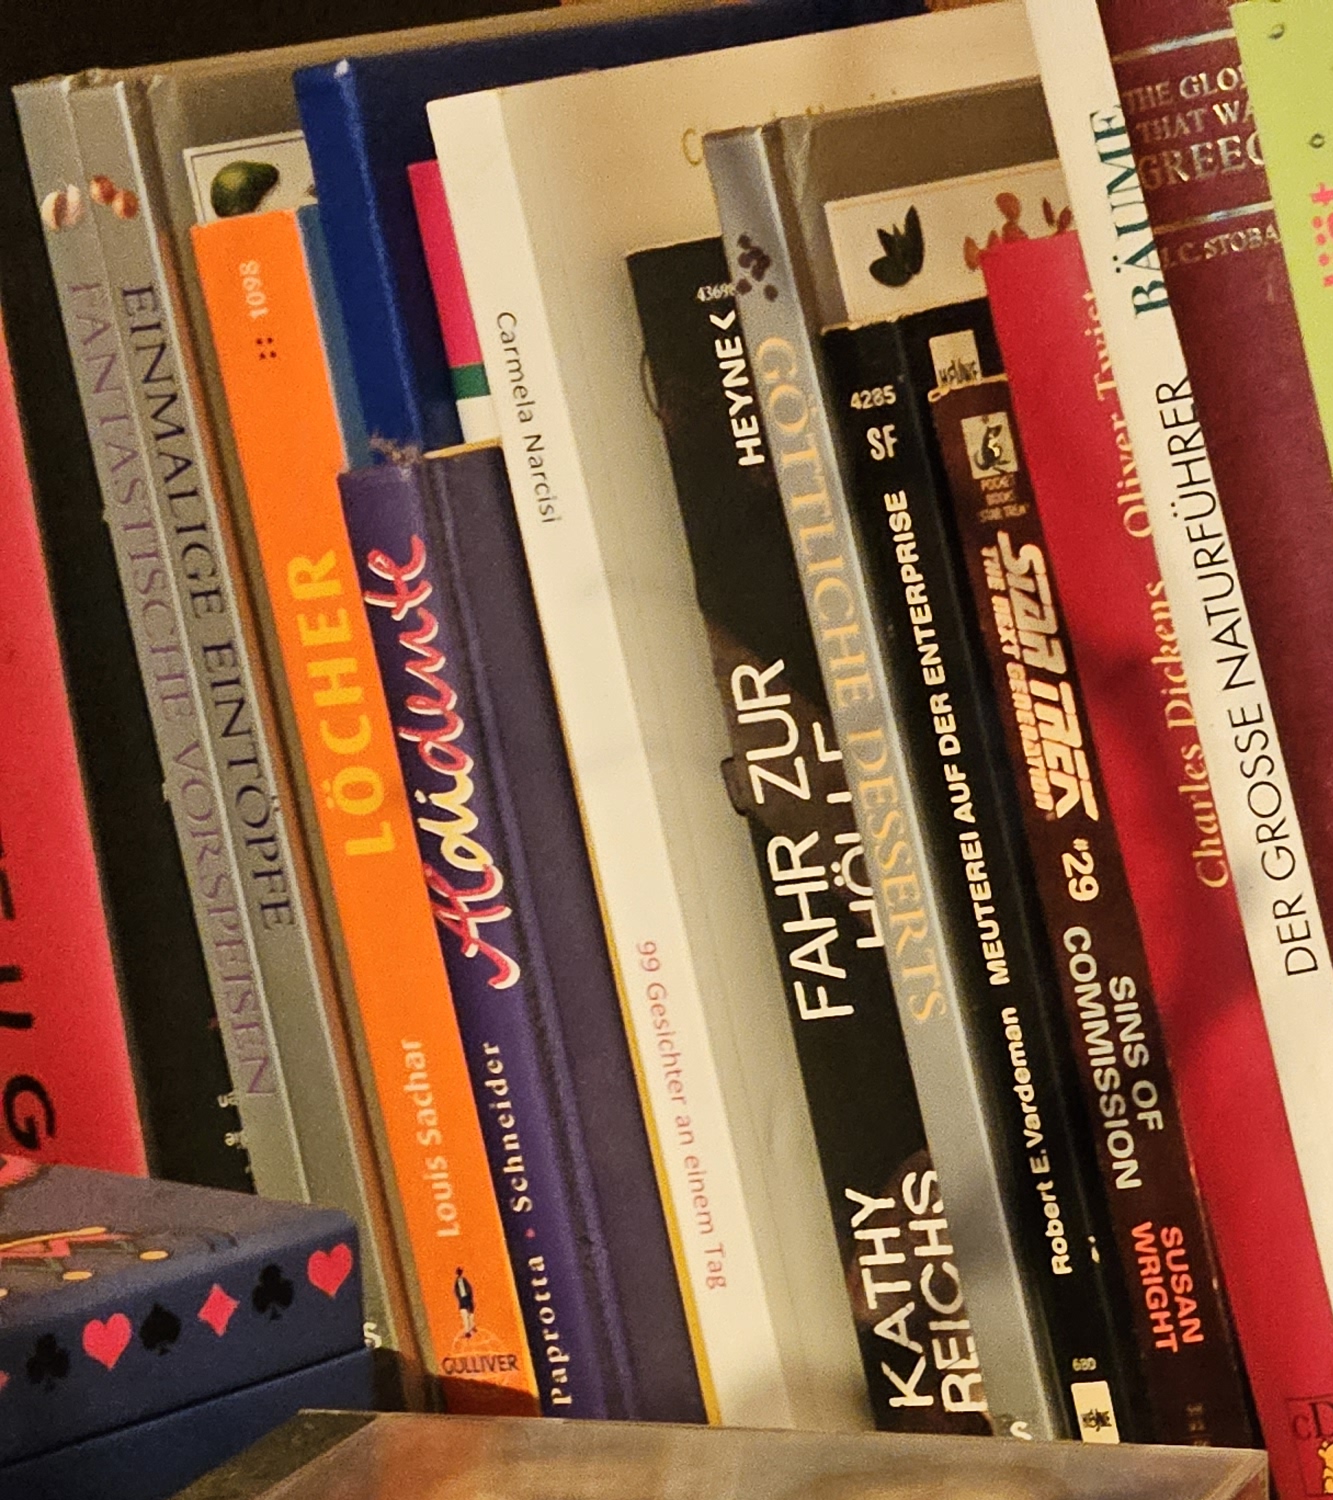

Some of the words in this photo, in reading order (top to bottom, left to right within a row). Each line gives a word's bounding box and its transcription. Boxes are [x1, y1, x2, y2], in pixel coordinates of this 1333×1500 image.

[1135, 108, 1208, 143] THAT
[1179, 67, 1248, 99] GLO
[1089, 104, 1169, 319] BÄUME
[240, 260, 270, 320] 1098
[495, 312, 534, 424] Carmela
[522, 433, 563, 524] Narcisi
[714, 337, 766, 468] HEYNE
[850, 384, 897, 411] 4285
[866, 425, 898, 462] SF
[883, 490, 946, 686] ENTERPRISE
[981, 545, 1007, 591] THE
[1155, 374, 1258, 692] NATURFÜHRER
[121, 283, 225, 619] EINMALIGE
[202, 640, 295, 931] EINTÖPFE
[991, 595, 1022, 660] NEXT
[997, 530, 1067, 675] STAR
[70, 282, 196, 723] FANTASTISCHE
[174, 740, 276, 1096] VORSPEISEN
[286, 548, 396, 857] LÖCHER
[731, 659, 811, 805] ZUR
[756, 337, 874, 708] GÖTTLICHE
[847, 729, 947, 1026] DESSERTS
[930, 693, 962, 757] DER
[1006, 661, 1054, 812] GENERATION
[942, 767, 976, 823] AUF
[1029, 681, 1099, 821] TREK
[1230, 703, 1297, 881] GROSSE
[637, 941, 660, 973] 99
[767, 831, 855, 1021] FAHR
[959, 831, 1010, 986] MEUTEREI
[1274, 891, 1318, 977] DER
[401, 1038, 443, 1147] Sachar
[646, 982, 688, 1106] Gesichter
[1001, 1006, 1044, 1149] Vardeman
[1063, 926, 1143, 1190] COMMISSION
[1108, 976, 1149, 1070] SINS
[1131, 1080, 1163, 1132] OF
[482, 1041, 533, 1214] Schneider
[676, 1114, 696, 1147] an
[684, 1154, 715, 1236] einem
[423, 1155, 461, 1239] Louis
[1040, 1180, 1072, 1276] Robert
[527, 1255, 573, 1407] Paprotta
[704, 1243, 728, 1290] Tag
[845, 1188, 935, 1409] KATHY
[902, 1169, 988, 1413] REICHS
[1130, 1221, 1178, 1353] WRIGHT
[1161, 1227, 1204, 1345] SUSAN
[441, 1353, 520, 1377] GULLIVER
